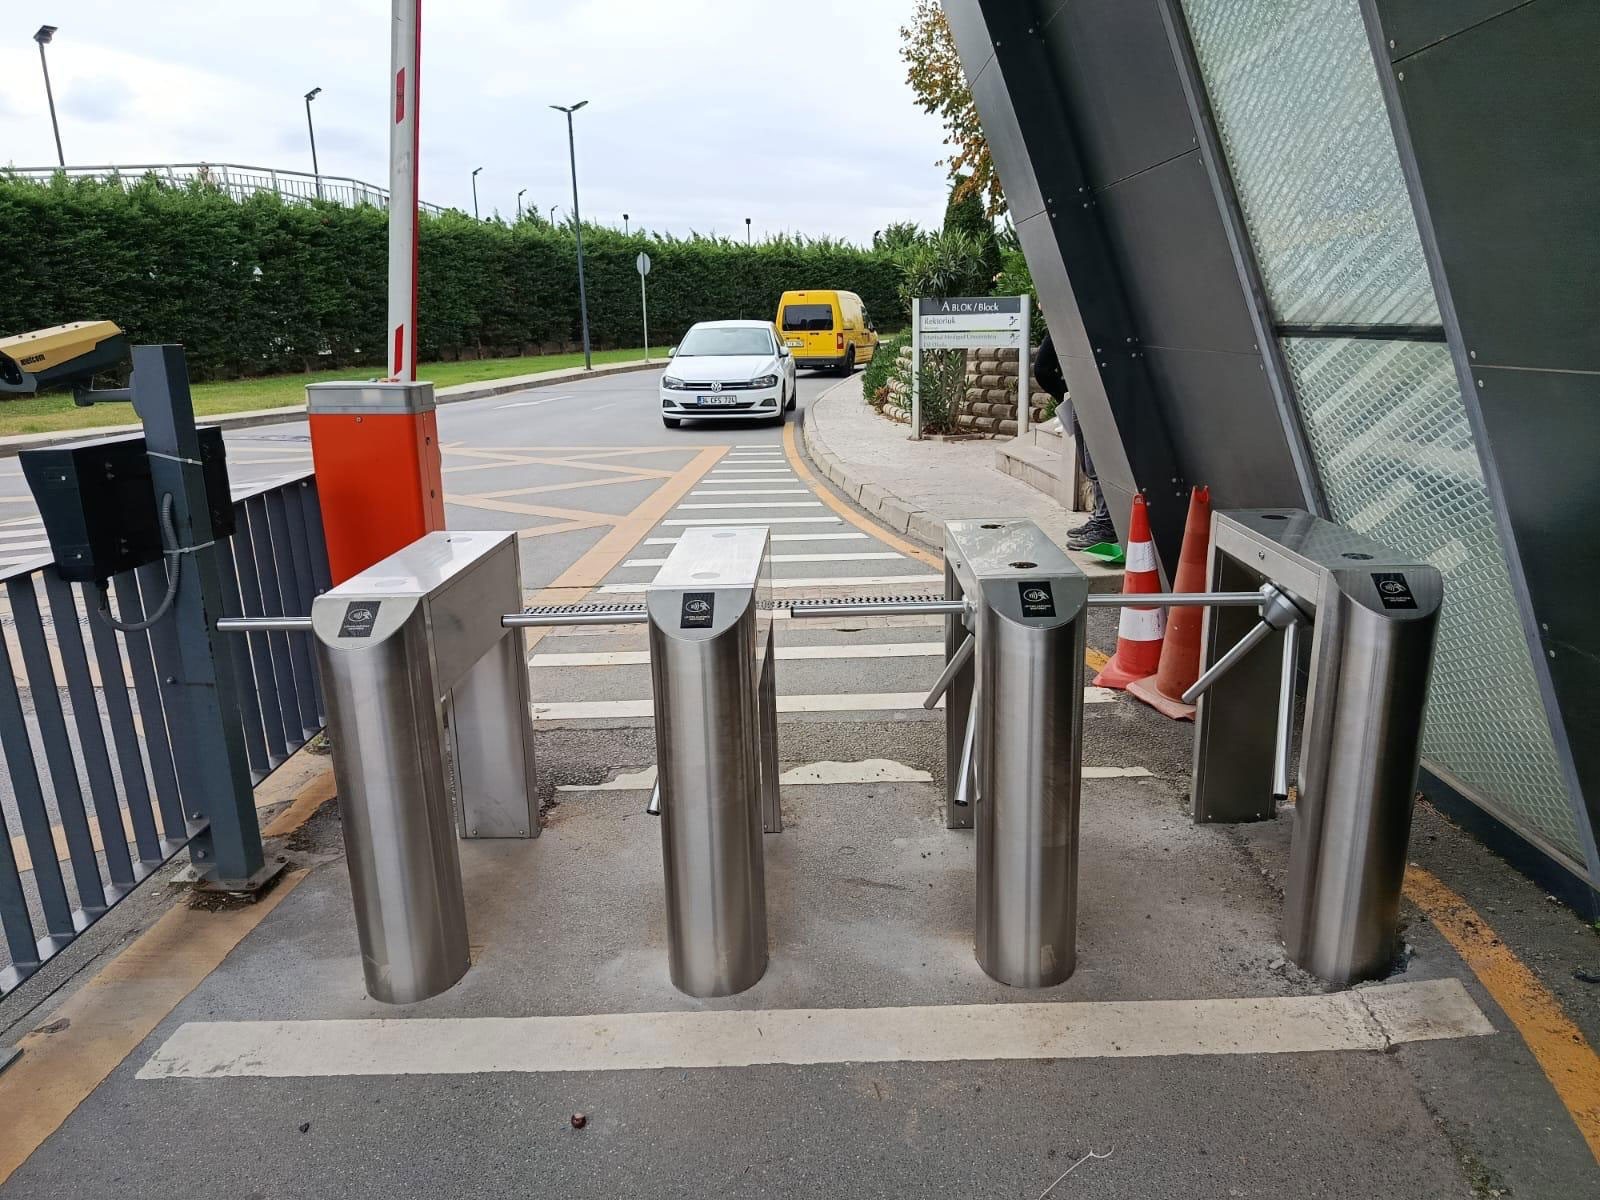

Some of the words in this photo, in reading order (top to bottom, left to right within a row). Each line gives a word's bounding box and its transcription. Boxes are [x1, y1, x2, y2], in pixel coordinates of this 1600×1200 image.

[941, 300, 950, 312] A
[952, 303, 972, 312] BLOK
[978, 302, 999, 312] Block
